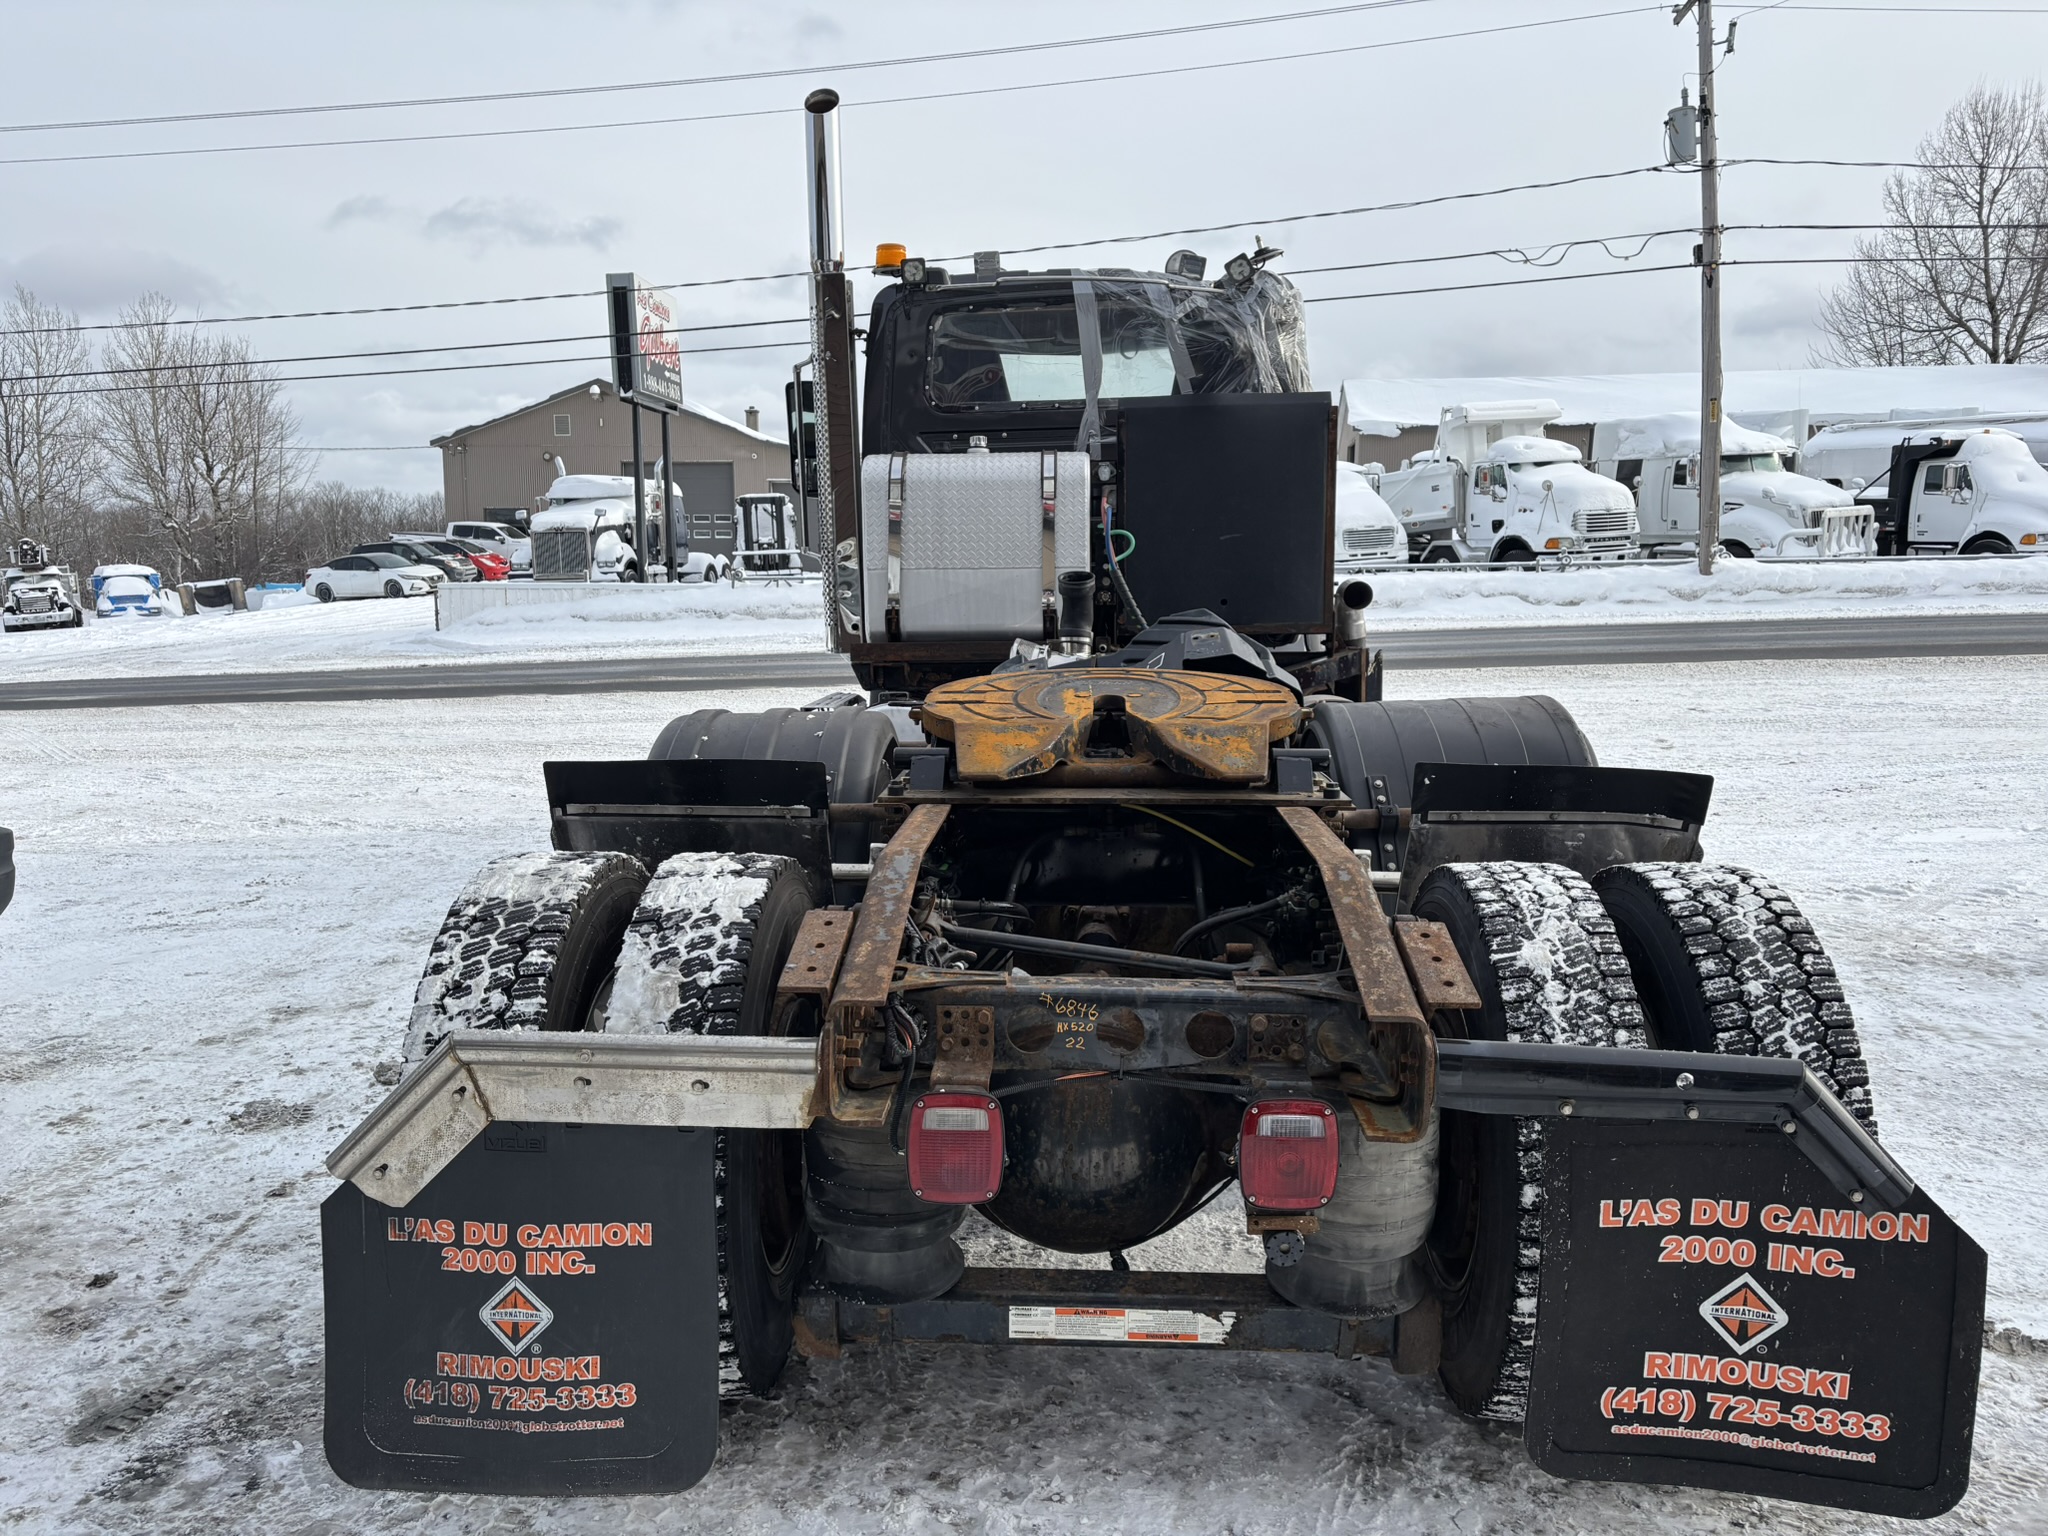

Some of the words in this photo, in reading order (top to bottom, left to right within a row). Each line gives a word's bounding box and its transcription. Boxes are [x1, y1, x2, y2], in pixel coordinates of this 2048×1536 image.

[1065, 1036, 1086, 1050] 22
[388, 1217, 455, 1243] L'AS
[464, 1221, 508, 1247] DU
[517, 1223, 652, 1248] CAMION
[1599, 1198, 1681, 1228] L'AS
[1690, 1198, 1749, 1228] DU
[1760, 1204, 1930, 1243] CAMION
[441, 1247, 516, 1275] 2000
[526, 1251, 595, 1275] INC.
[1658, 1236, 1756, 1268] 2000
[1767, 1242, 1856, 1279] INC.
[488, 1310, 544, 1321] INTERNATIONAL
[1710, 1305, 1777, 1321] INTERNATIONAL
[437, 1352, 600, 1382] RIMOUSKI
[1643, 1352, 1851, 1400] RIMOUSKI
[404, 1378, 480, 1413] (418)
[488, 1384, 637, 1411] 725-3333
[1600, 1387, 1696, 1422] (418)
[1707, 1392, 1890, 1441] 725-3333
[1611, 1424, 1876, 1463] asducamion2000@globetrotter.net
